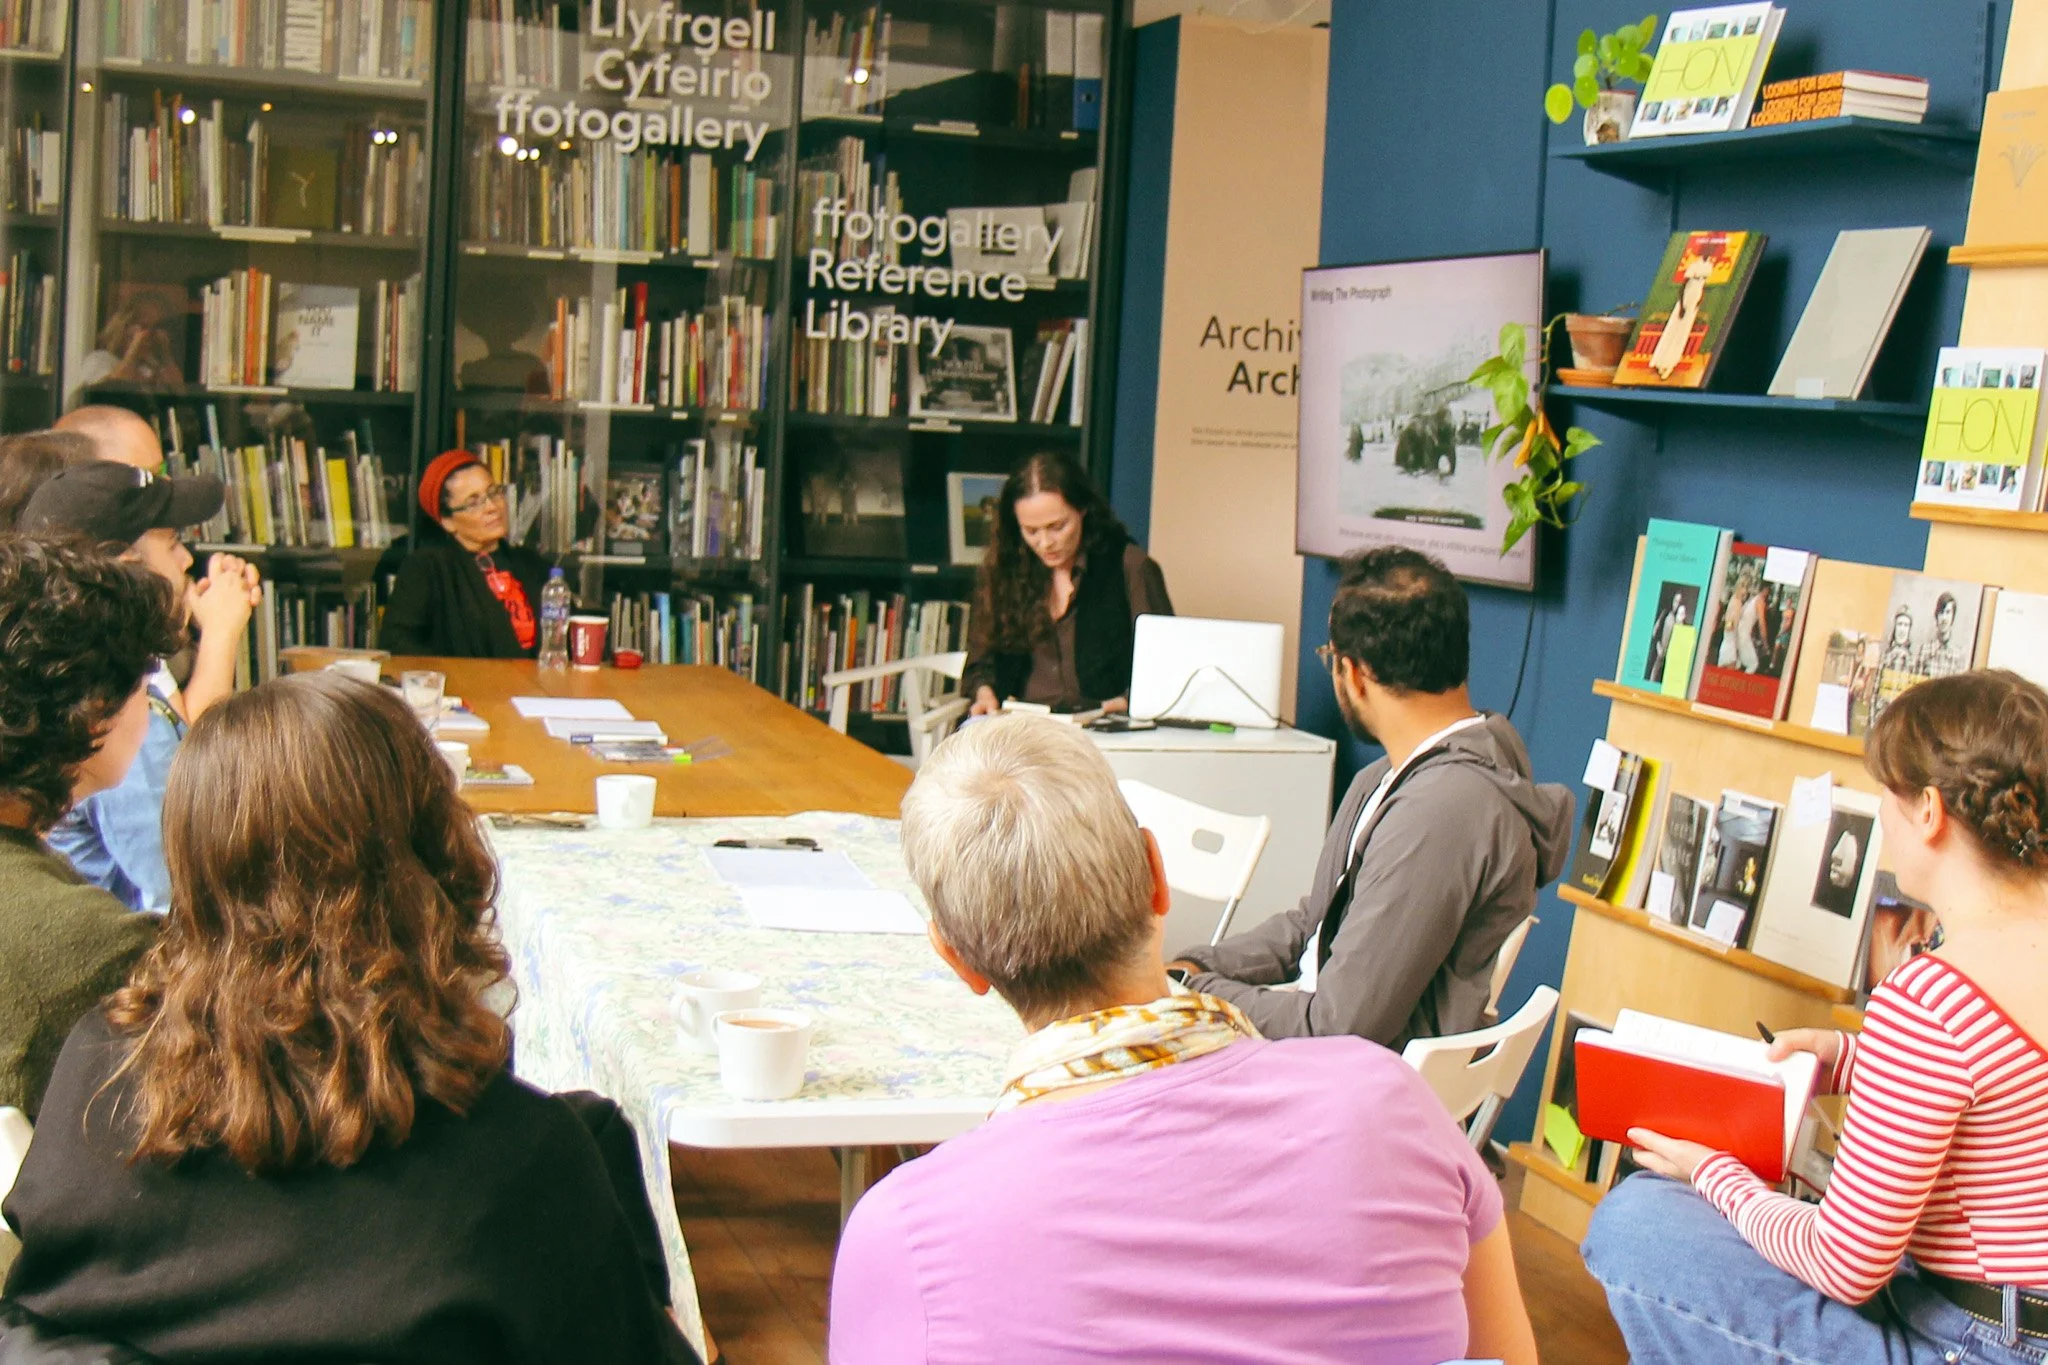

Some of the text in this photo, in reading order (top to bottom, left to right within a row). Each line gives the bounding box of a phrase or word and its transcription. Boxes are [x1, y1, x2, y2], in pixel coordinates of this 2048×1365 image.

[590, 0, 776, 56] Llyfrgell
[594, 49, 772, 101] Cyfeirio
[1652, 44, 1748, 93] HON
[1763, 79, 1799, 100] LOOKING
[1799, 76, 1817, 96] FOR
[495, 91, 770, 162] ffotogallery
[1751, 108, 1792, 127] LOOKING
[1792, 105, 1811, 125] FOR
[812, 196, 1065, 265] ffotogallery
[808, 248, 1027, 302] Reference
[1335, 286, 1348, 301] The
[1350, 284, 1392, 304] Photograph
[806, 298, 955, 359] Library
[1932, 396, 2028, 455] HON
